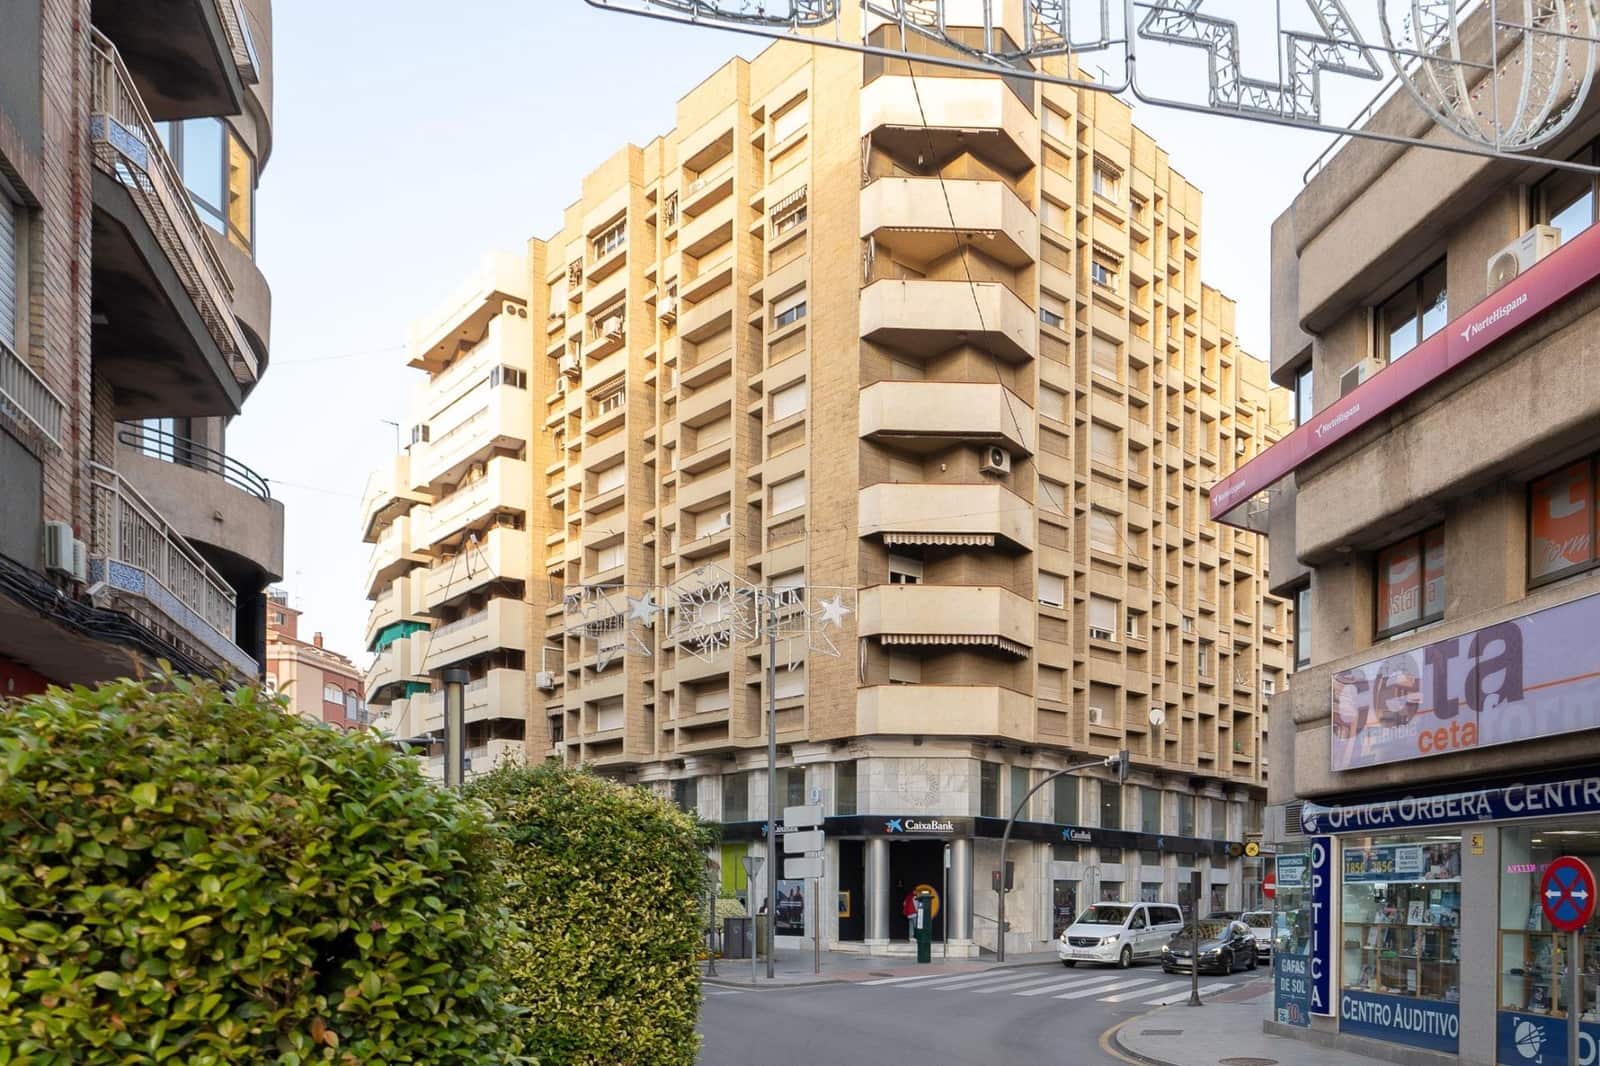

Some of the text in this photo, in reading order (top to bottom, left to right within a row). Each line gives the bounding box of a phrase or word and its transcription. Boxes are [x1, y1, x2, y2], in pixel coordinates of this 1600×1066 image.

[1471, 293, 1528, 336] NorteHispana
[1417, 719, 1477, 753] ceta
[905, 819, 954, 832] CaixaBank
[1328, 804, 1395, 828] OPTICA
[1398, 795, 1492, 821] ORBERA
[1311, 843, 1326, 1007] OPTICA
[1281, 958, 1306, 974] GAFAS
[1280, 977, 1307, 994] DE SOL
[1342, 996, 1459, 1038] CENTRO AUDITIVO
